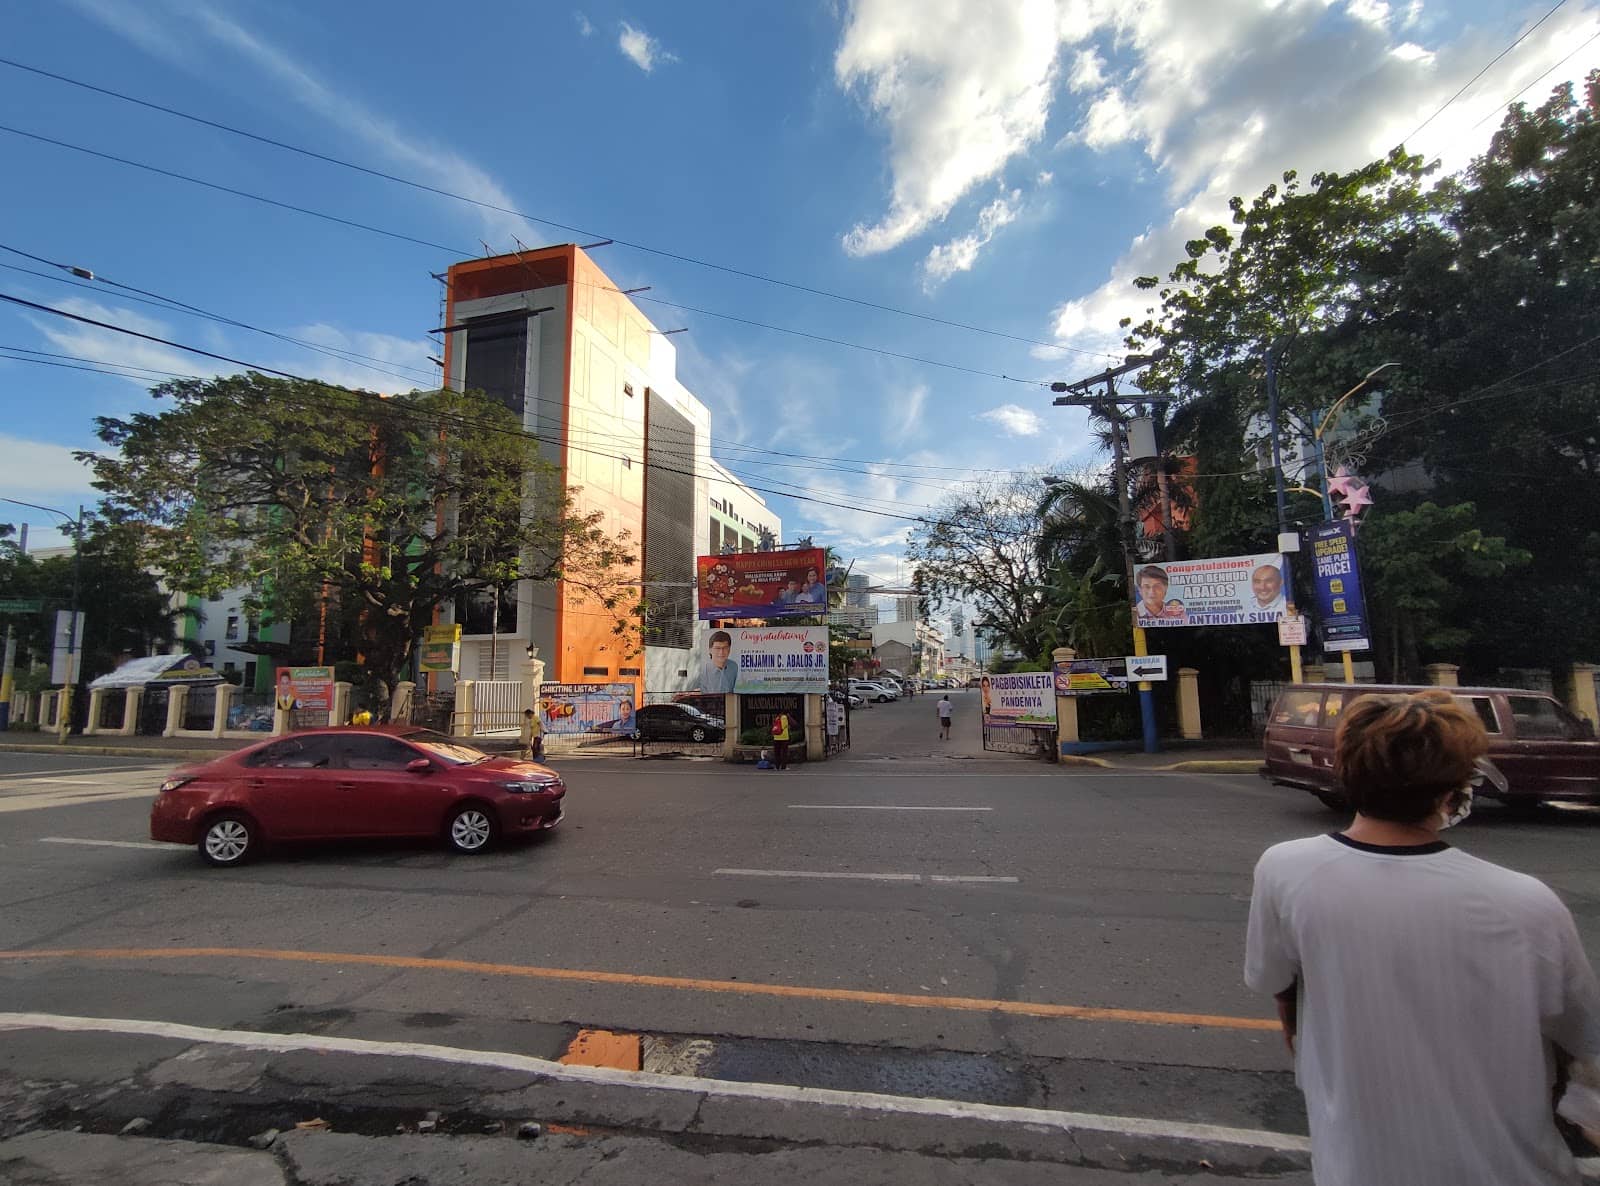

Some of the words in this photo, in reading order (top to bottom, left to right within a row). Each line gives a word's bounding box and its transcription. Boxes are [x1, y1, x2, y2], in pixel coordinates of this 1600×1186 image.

[1328, 536, 1347, 545] SPEED
[1315, 544, 1348, 557] UPGRADE!
[1333, 552, 1349, 562] PLAN
[1166, 559, 1254, 574] Congratulations!
[1318, 560, 1351, 577] PRICE!
[1170, 574, 1205, 586] MAYOR
[1183, 583, 1236, 600] ABALOS
[1158, 618, 1184, 627] Mayor
[1189, 613, 1245, 625] ANTHONY
[740, 630, 809, 645] Congratulations!
[741, 654, 775, 668] BENJAMIN
[777, 654, 784, 668] C.
[786, 654, 813, 668] ABALOS
[815, 654, 827, 668] JR.
[990, 675, 1052, 690] PAGBIBISIKLETA
[1001, 696, 1042, 708] PANDEMYA
